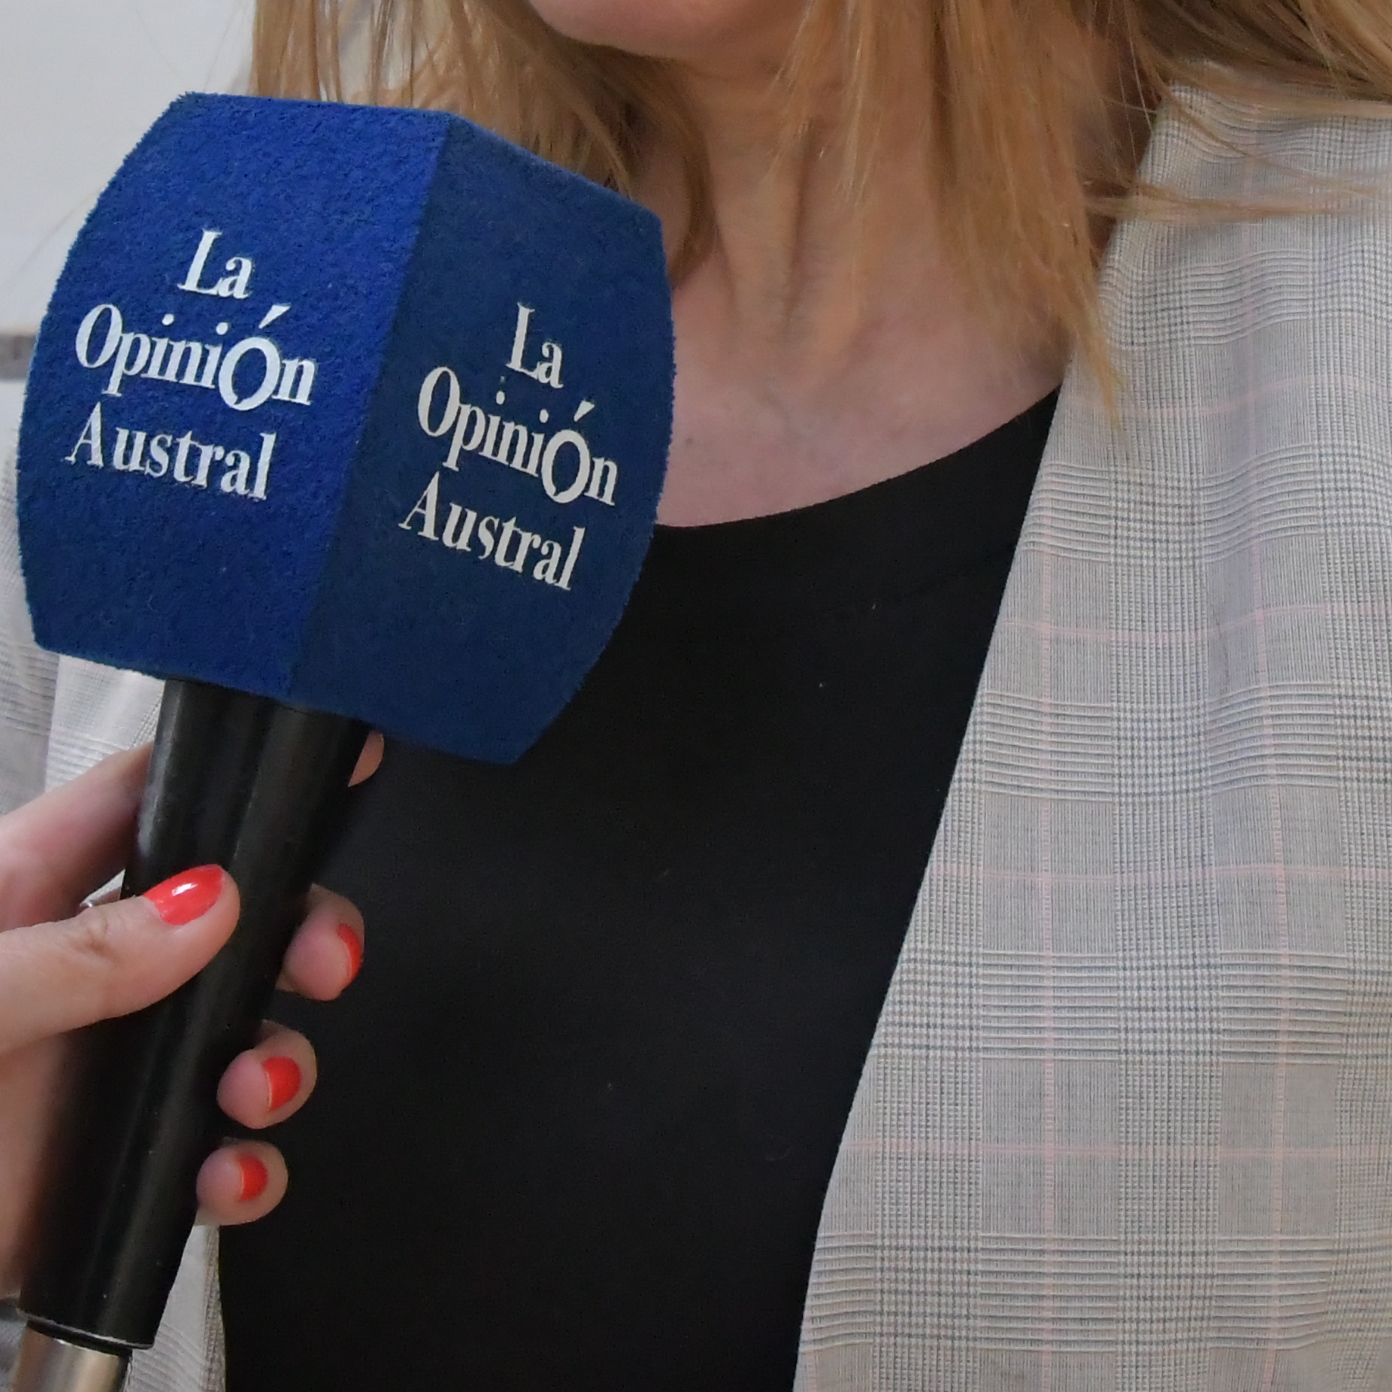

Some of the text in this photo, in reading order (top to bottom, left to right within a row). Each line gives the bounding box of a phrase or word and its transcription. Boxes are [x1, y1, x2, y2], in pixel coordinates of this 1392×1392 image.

[178, 229, 253, 299] La
[506, 301, 564, 390] La
[64, 401, 277, 501] Austral
[398, 471, 587, 592] Austral
